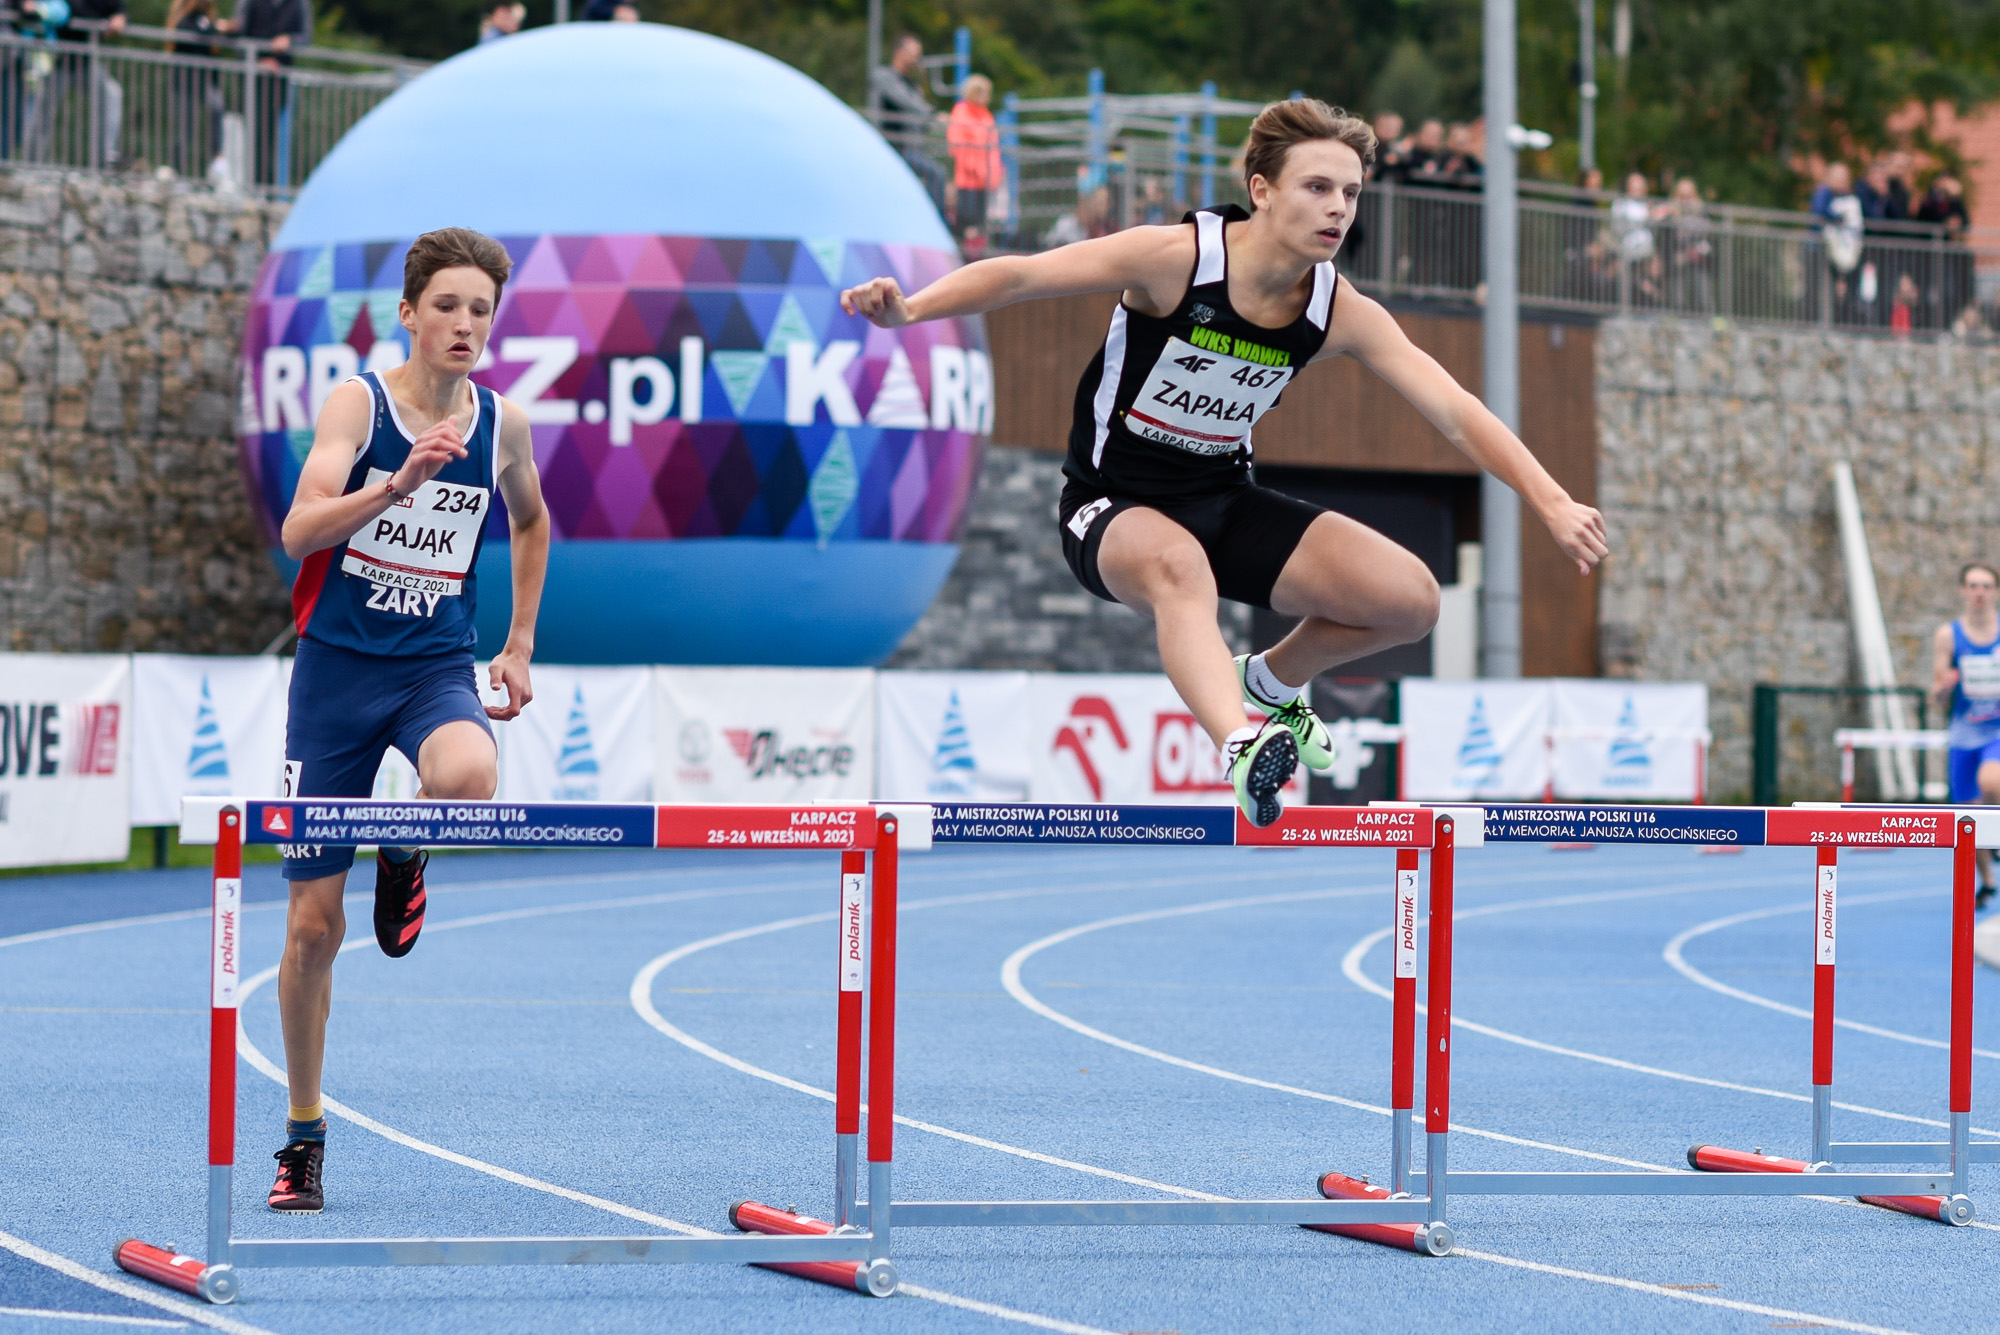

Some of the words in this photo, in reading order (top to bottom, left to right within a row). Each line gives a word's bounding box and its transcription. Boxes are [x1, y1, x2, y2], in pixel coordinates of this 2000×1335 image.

[1190, 325, 1231, 355] WKS
[1173, 355, 1217, 374] 4F
[1230, 365, 1286, 389] 467
[1152, 379, 1255, 423] ZAPAŁA
[1141, 426, 1204, 452] KARPACZ
[432, 488, 482, 515] 234
[374, 518, 457, 558] PAJĄK
[360, 564, 421, 589] KARPACZ
[423, 580, 450, 593] 2021
[283, 763, 293, 798] 6
[306, 806, 342, 820] PZLA
[343, 807, 444, 821] MISTRZOSTWA
[447, 808, 497, 822] POLSKI
[500, 808, 527, 822] U16
[791, 811, 856, 825] KARPACZ
[931, 808, 952, 820] ZLA
[956, 808, 1045, 821] MISTRZOSTWA
[1049, 809, 1092, 822] POLSKI
[1095, 809, 1119, 822] U16
[1356, 813, 1415, 825] KARPACZ
[1503, 809, 1586, 822] MISTRZOSTWA
[1589, 810, 1631, 823] POLSKI
[1634, 811, 1656, 823] U16
[1881, 817, 1938, 829] KARPACZ
[305, 825, 348, 839] MAŁY
[351, 825, 432, 840] MEMORIAŁ
[436, 826, 500, 841] JANUSZA
[504, 824, 624, 842] KUSOCIŃSKIEGO
[707, 830, 747, 844] 25-26
[750, 827, 820, 844] WRZEŚNIA
[823, 830, 855, 844] 2021
[932, 824, 959, 836] AŁY
[963, 824, 1035, 838] MEMORIAŁ
[1038, 825, 1097, 839] JANUSZA
[1100, 823, 1206, 840] KUSOCIŃSKIEGO
[1281, 829, 1317, 841] 25-26
[1320, 826, 1382, 842] WRZEŚNIA
[1385, 829, 1414, 842] 2021
[1484, 825, 1506, 836] AŁY
[1509, 825, 1576, 838] MEMORIAŁ
[1580, 826, 1635, 839] JANUSZA
[1638, 825, 1738, 841] KUSOCIŃSKIEGO
[1810, 831, 1844, 844] 25-26
[1846, 829, 1906, 844] WRZEŚNIA
[1908, 832, 1936, 844] 2021
[284, 844, 322, 858] ARY
[1401, 892, 1415, 951] polanik
[1822, 889, 1834, 939] polanik
[847, 901, 861, 961] polanik
[220, 911, 236, 975] polanik
